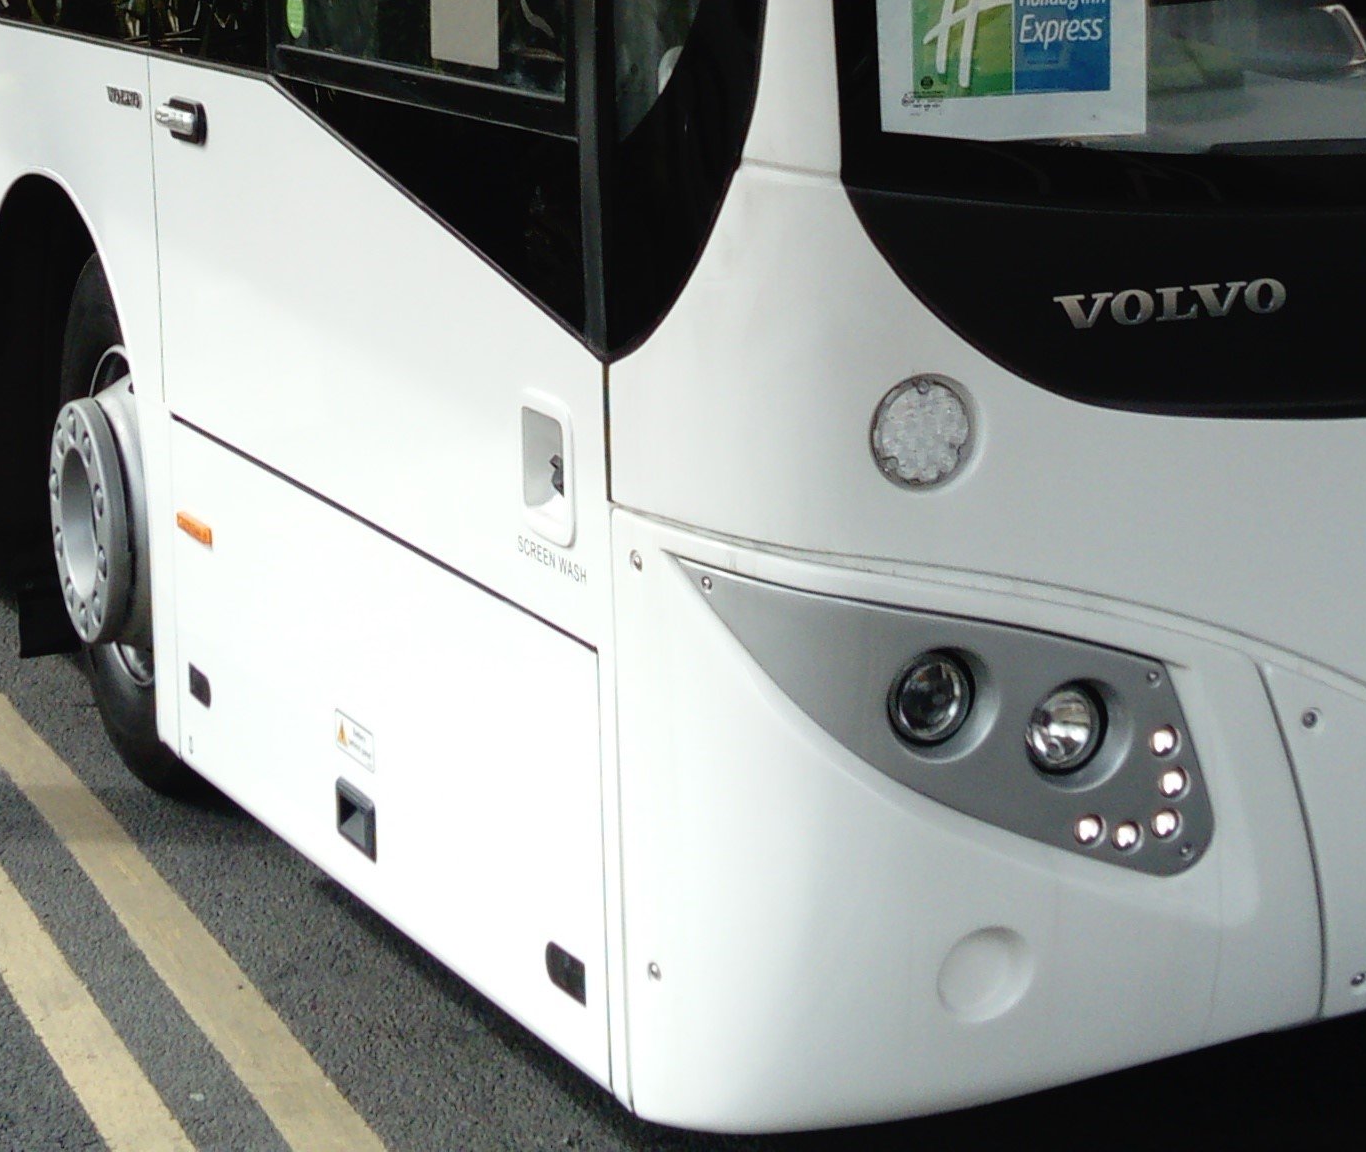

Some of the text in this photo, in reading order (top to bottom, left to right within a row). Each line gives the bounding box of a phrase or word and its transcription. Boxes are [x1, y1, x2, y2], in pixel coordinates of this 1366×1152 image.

[1019, 13, 1104, 50] Express
[1053, 278, 1287, 330] VOLVO
[517, 535, 588, 584] SCREEN WASH
